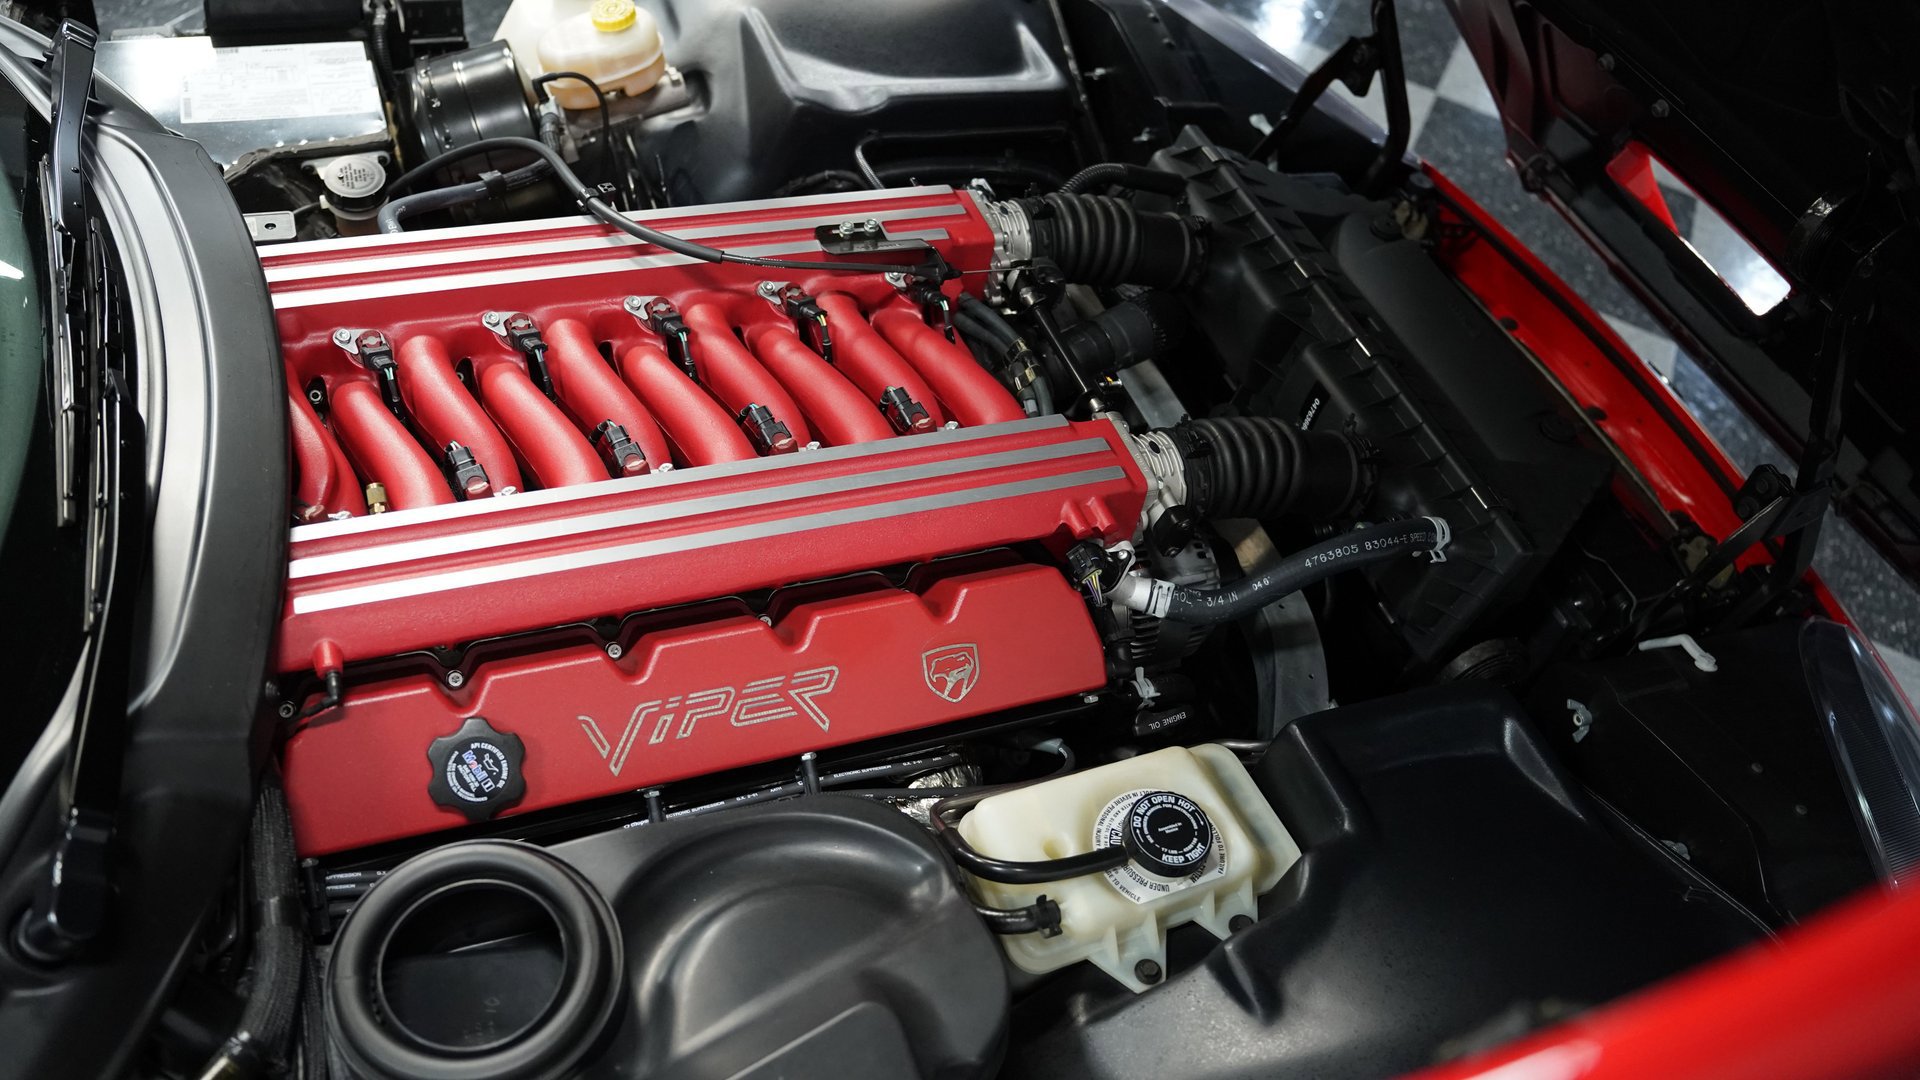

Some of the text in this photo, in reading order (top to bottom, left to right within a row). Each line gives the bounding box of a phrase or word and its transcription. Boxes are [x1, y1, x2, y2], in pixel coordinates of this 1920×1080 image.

[1304, 544, 1359, 568] 4763805
[1206, 595, 1225, 607] 3/4
[1228, 591, 1239, 604] IN
[1148, 711, 1187, 730] ENGINE OIL
[462, 750, 489, 782] Mobil
[1114, 794, 1132, 806] SEVERE
[1136, 800, 1151, 815] NOT
[1151, 796, 1175, 804] OPEN
[1177, 799, 1196, 812] HOT
[666, 809, 691, 819] ECTRONIC
[1097, 805, 1115, 826] PERSONAL
[1133, 815, 1142, 828] DO
[1161, 853, 1185, 864] KEEP
[1185, 842, 1206, 861] TIGHT
[1218, 853, 1226, 875] FAILURE
[1112, 878, 1142, 902] TO VEHICLE
[1149, 882, 1170, 892] UNDER
